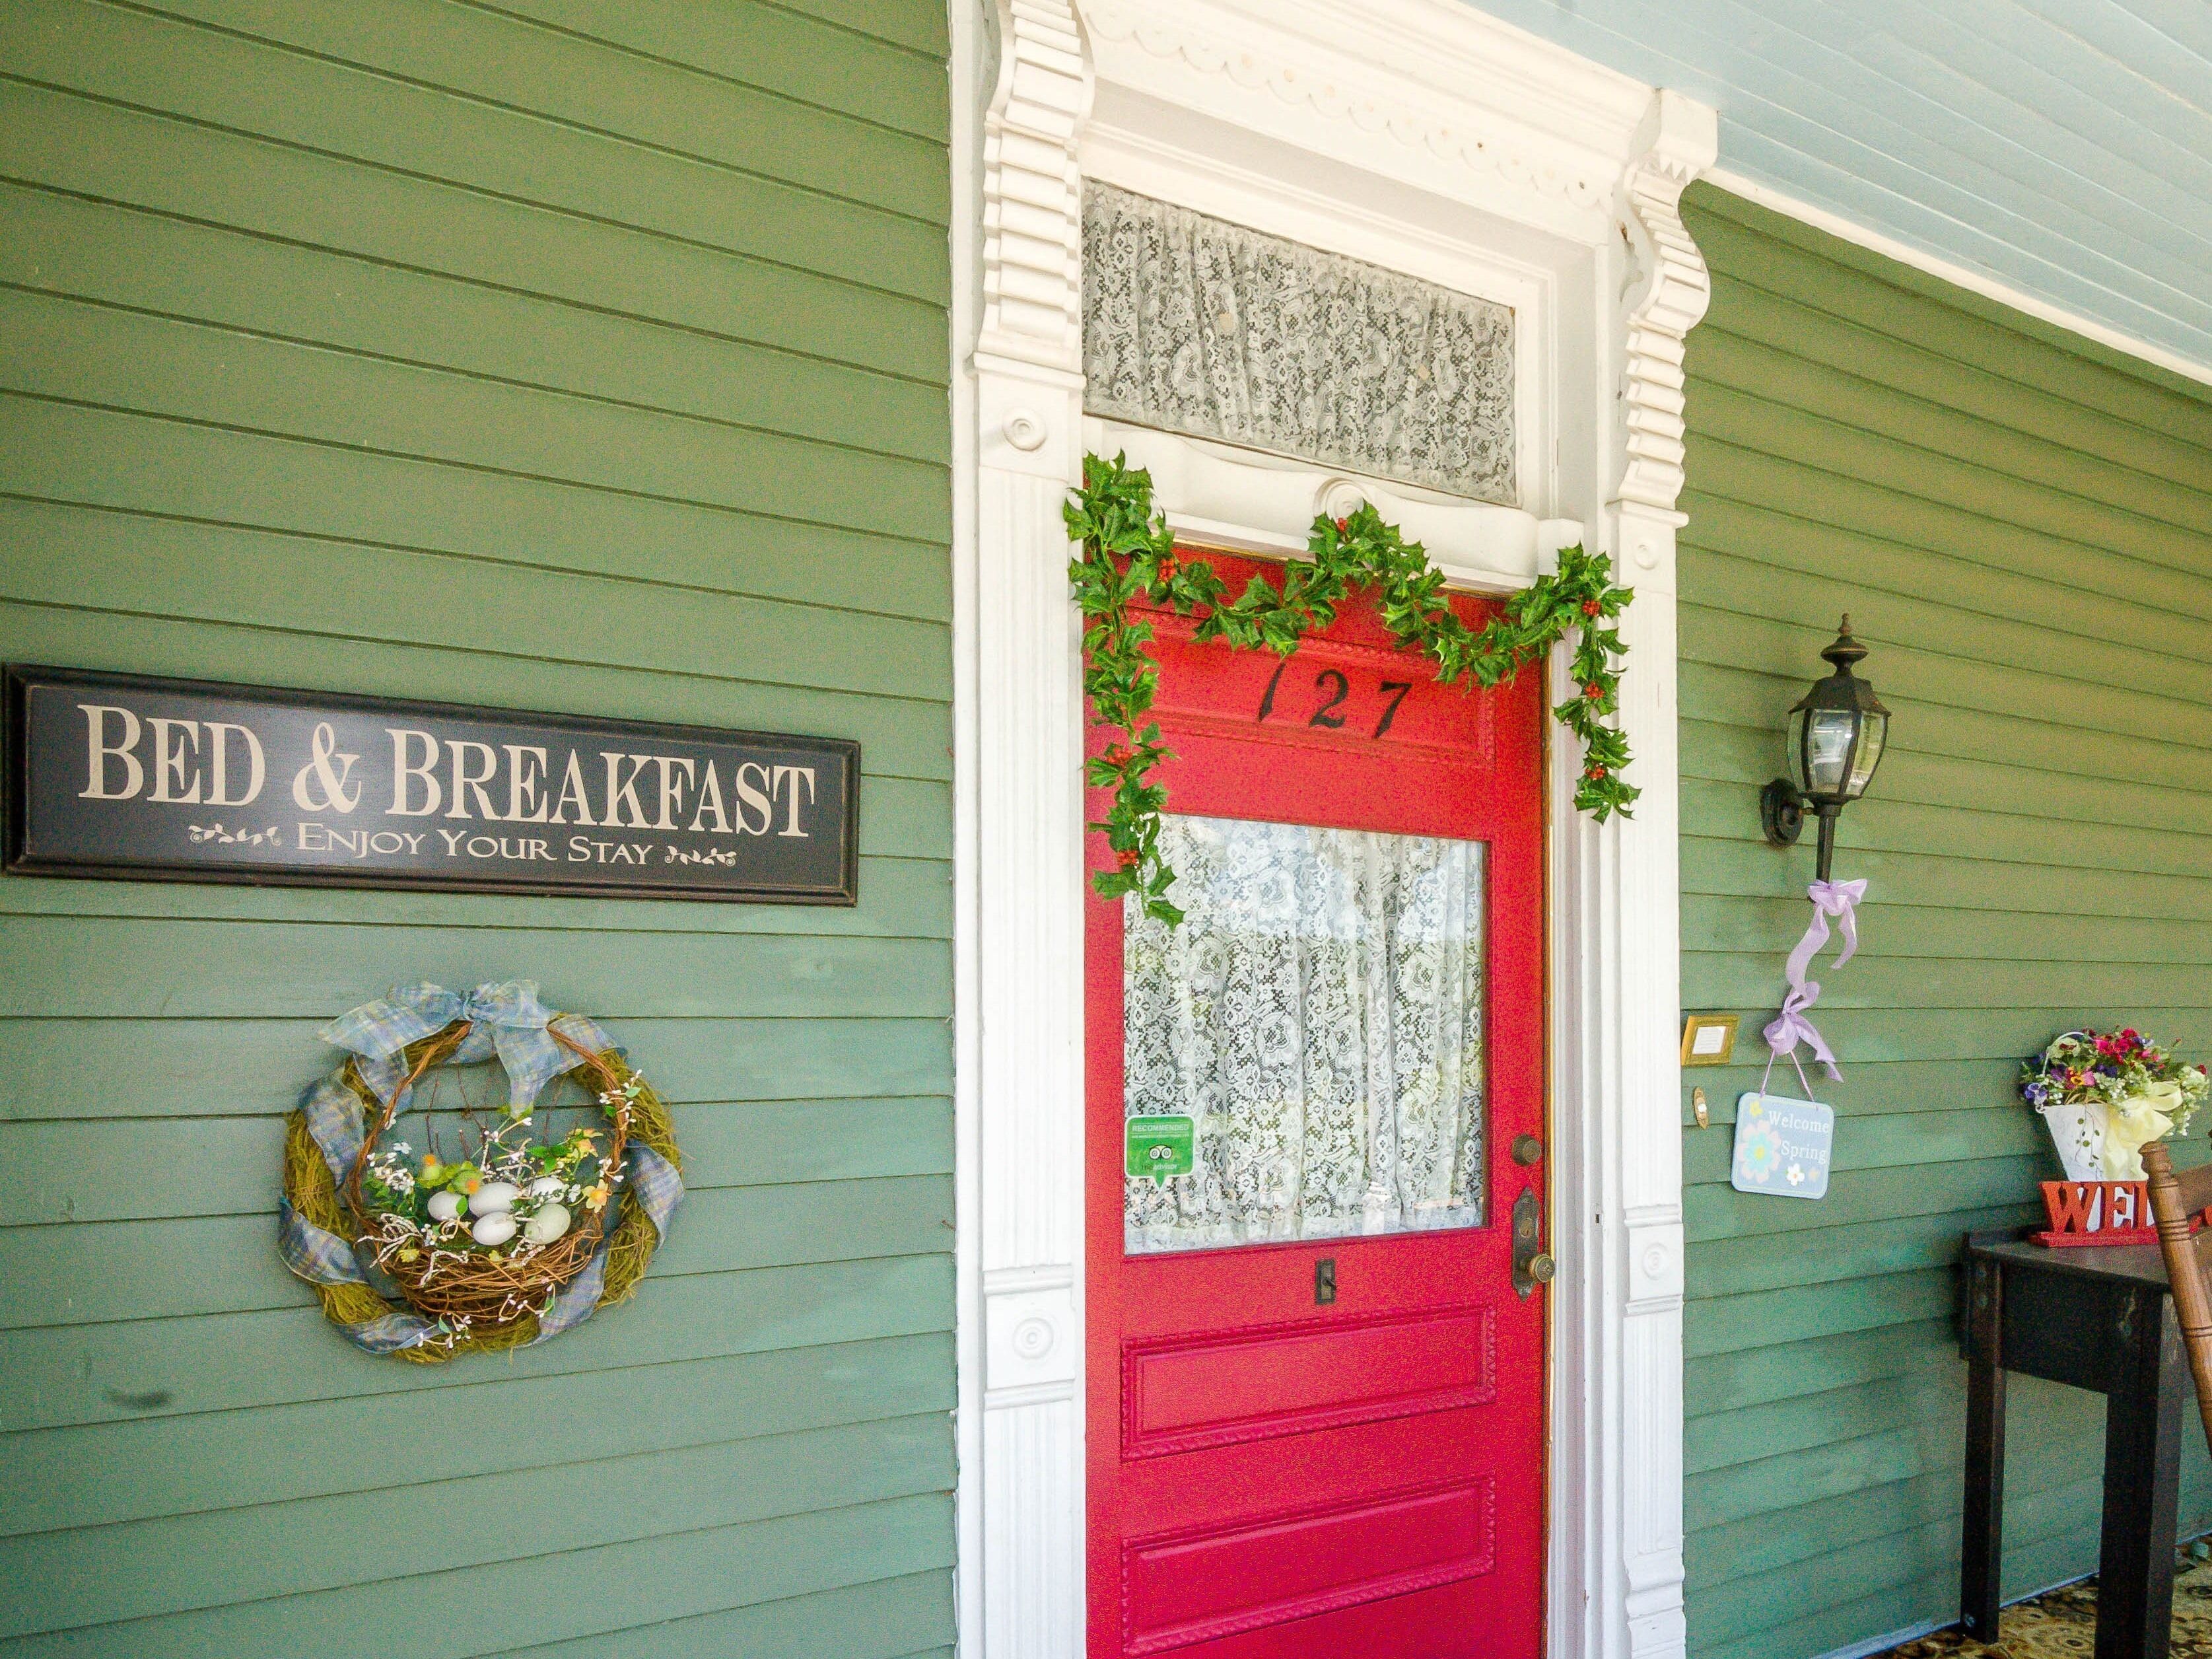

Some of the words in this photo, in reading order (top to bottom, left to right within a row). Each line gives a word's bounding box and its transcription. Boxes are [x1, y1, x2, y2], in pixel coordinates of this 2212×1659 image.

[77, 704, 265, 806] BED
[291, 721, 362, 814] &
[384, 728, 815, 838] BREAKFAST
[295, 822, 427, 859] ENJOY
[436, 829, 557, 861] YOUR
[568, 835, 654, 865] STAY
[1767, 1110, 1830, 1133] Welcome
[1780, 1141, 1828, 1164] Spring
